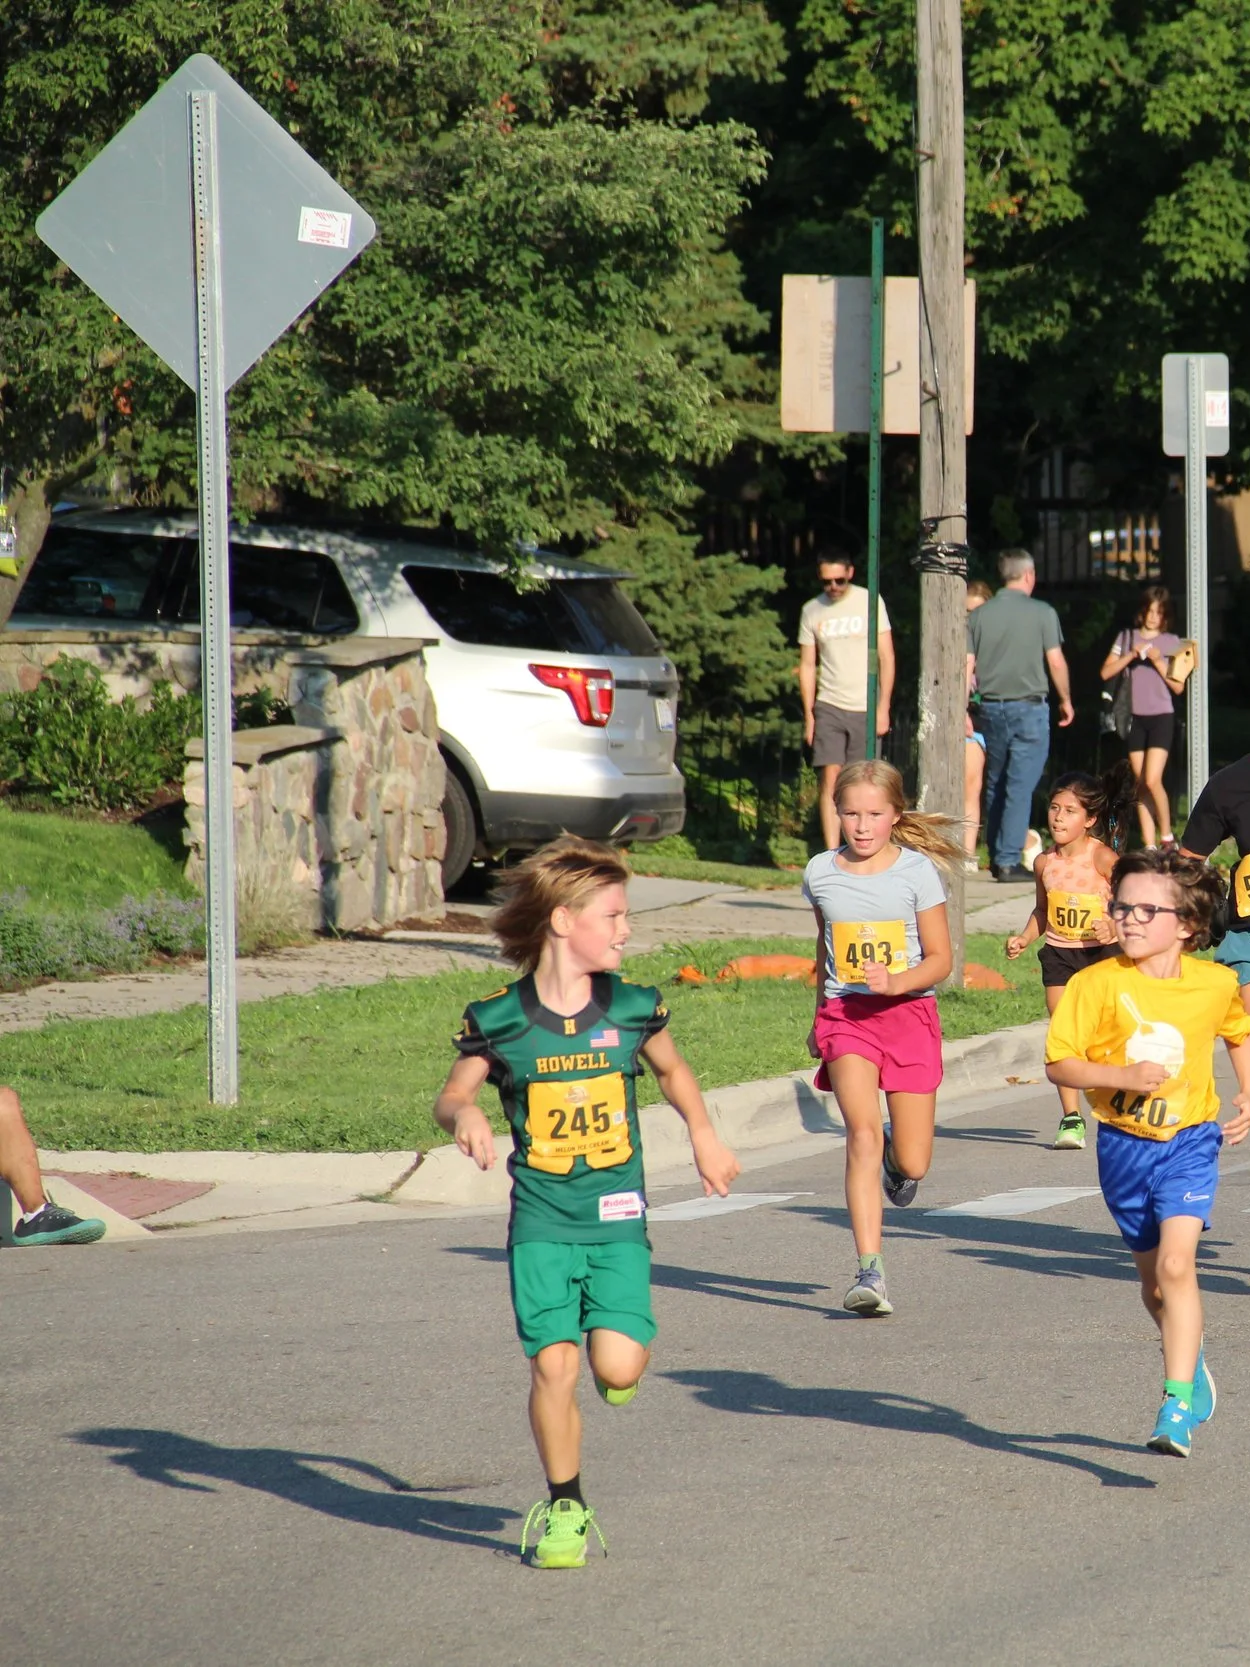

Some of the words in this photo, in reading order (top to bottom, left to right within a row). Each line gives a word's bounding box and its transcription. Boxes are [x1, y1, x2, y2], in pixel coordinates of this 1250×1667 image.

[1056, 906, 1091, 929] 507
[845, 941, 893, 970] 493
[564, 1019, 576, 1035] H
[536, 1052, 610, 1074] HOWELL
[1110, 1089, 1167, 1127] 440
[548, 1101, 610, 1139] 245
[555, 1145, 576, 1153] MELON
[577, 1143, 587, 1151] ICE
[588, 1139, 610, 1148] CREAM
